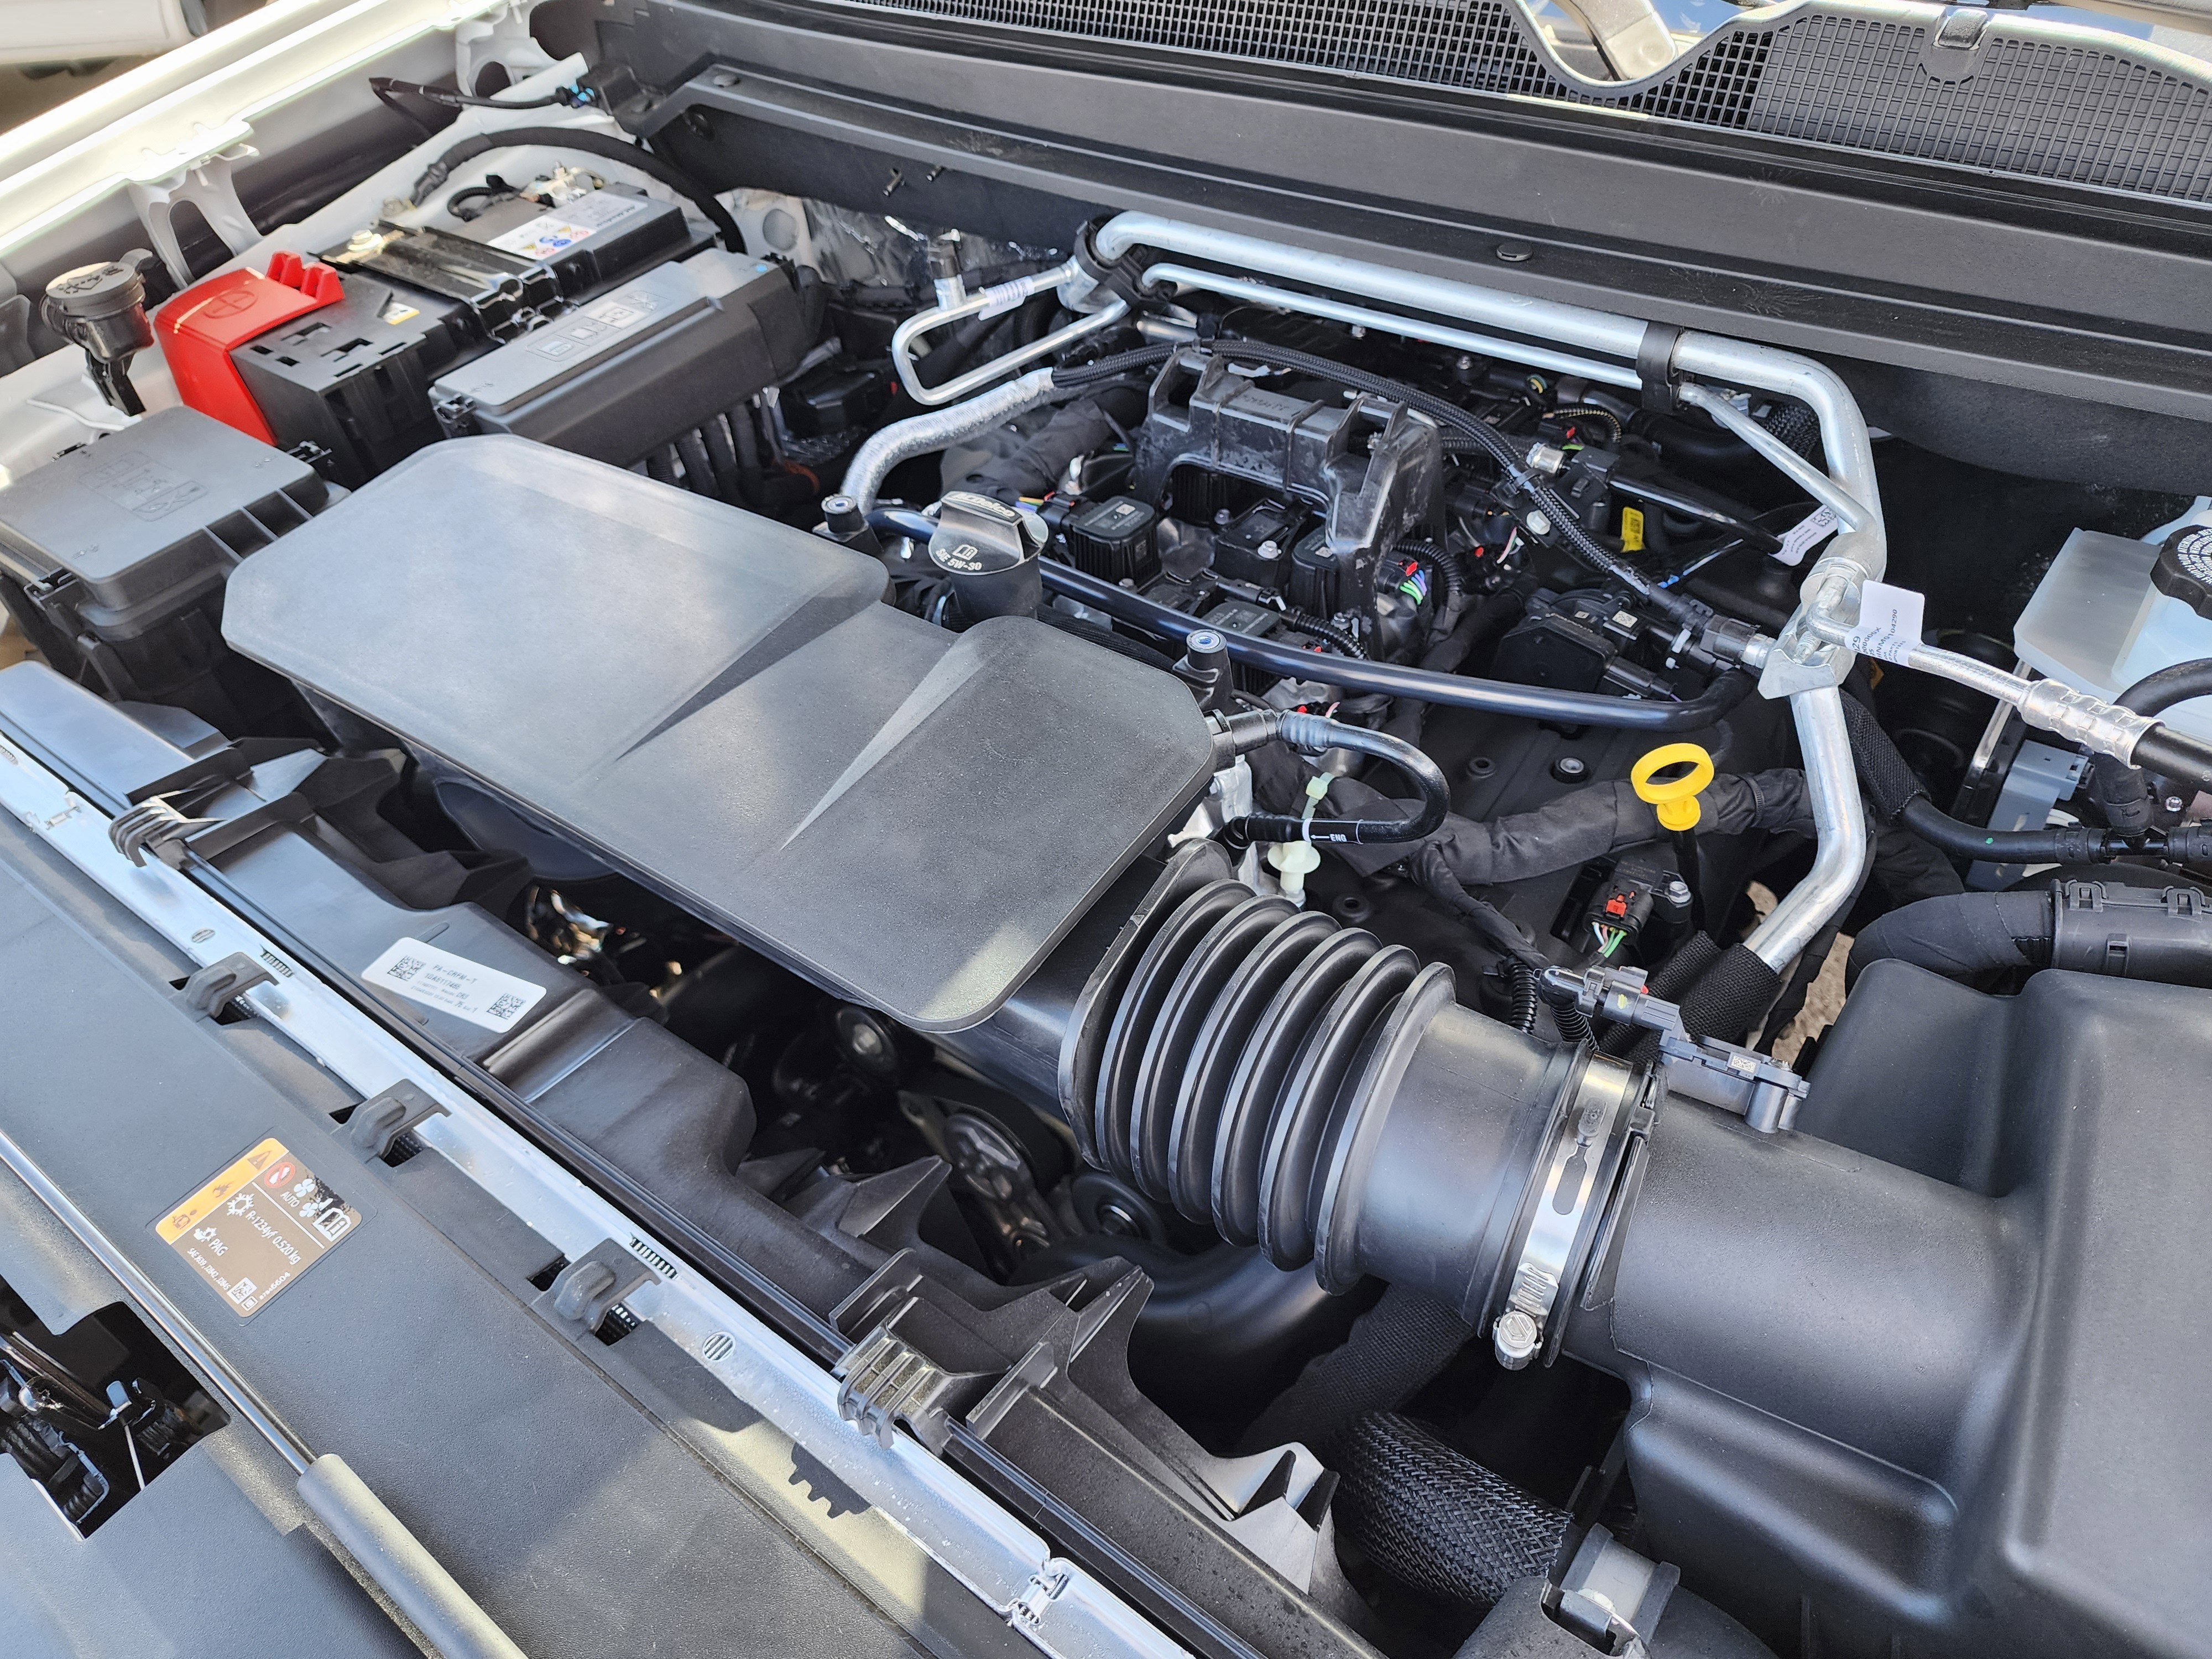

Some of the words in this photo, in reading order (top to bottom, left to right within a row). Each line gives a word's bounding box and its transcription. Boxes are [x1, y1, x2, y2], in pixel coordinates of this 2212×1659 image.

[952, 493, 1015, 517] ACDelco
[936, 548, 951, 562] SAE
[947, 558, 982, 571] 5W-30
[2184, 565, 2205, 578] FLUID
[1329, 833, 1347, 842] ENG
[280, 1191, 300, 1207] AUTO
[245, 1210, 278, 1239] R-1234yf
[208, 1238, 229, 1256] PAG
